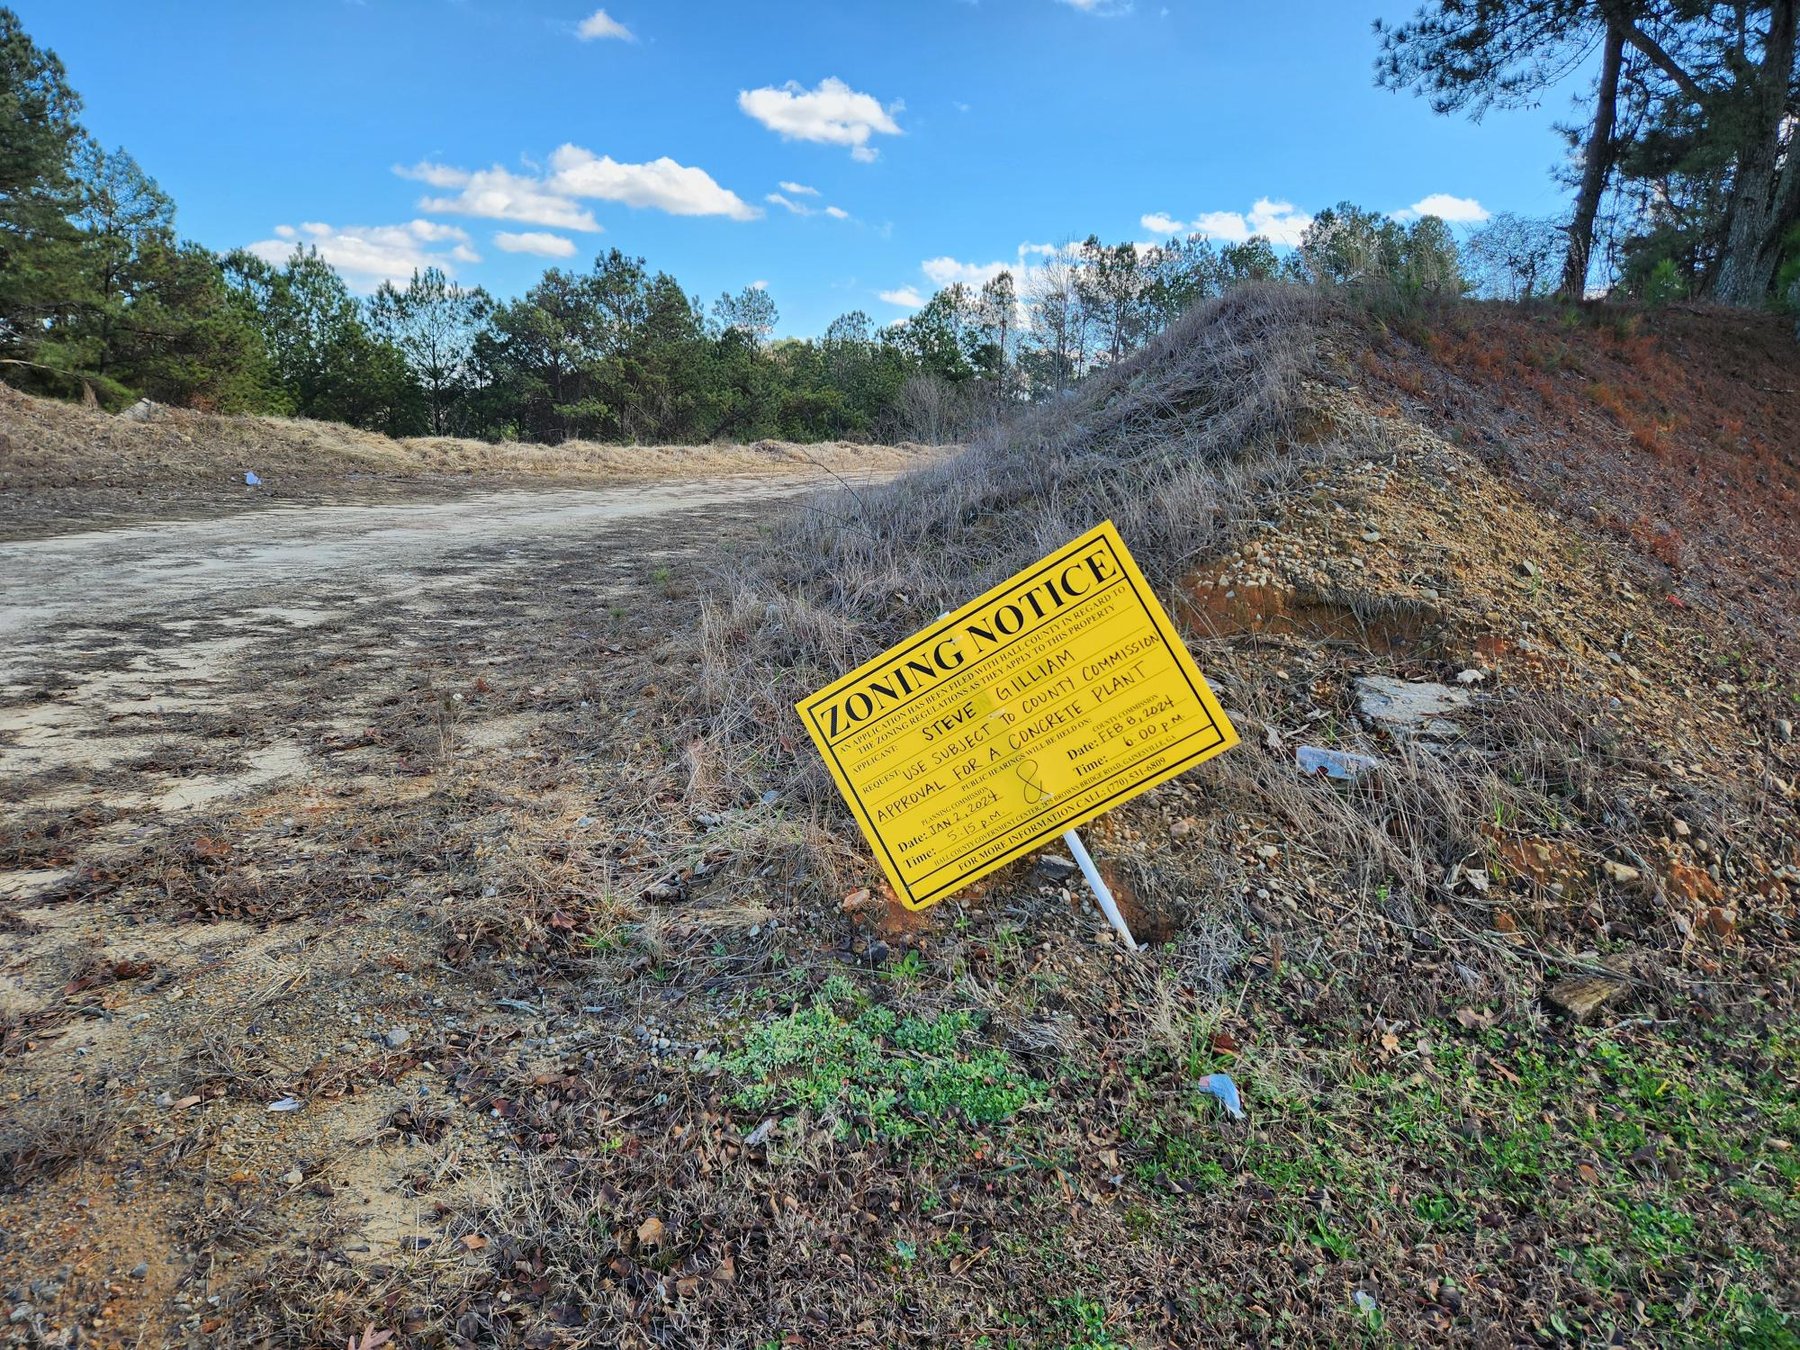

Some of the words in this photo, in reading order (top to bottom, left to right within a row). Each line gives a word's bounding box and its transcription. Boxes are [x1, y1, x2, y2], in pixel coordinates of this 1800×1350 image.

[819, 636, 966, 738] ZONING
[964, 548, 1118, 654] NOTICE
[839, 743, 852, 753] AN
[852, 710, 907, 746] APPLICATION
[907, 701, 925, 715] HAS
[925, 686, 948, 704] BEEN
[948, 672, 974, 691] FILED
[974, 657, 999, 675] WITH
[998, 644, 1024, 662] HALL
[1023, 622, 1061, 648] COUNTY
[1060, 616, 1072, 626] IN
[1072, 593, 1112, 620] REGARD
[1111, 585, 1126, 597] TO
[857, 740, 875, 754] THE
[875, 721, 909, 744] ZONING
[909, 687, 969, 726] REGULATIONS
[969, 680, 980, 691] AS
[979, 666, 1004, 685] THEY
[1005, 650, 1032, 671] APPLY
[1032, 643, 1046, 654] TO
[1046, 631, 1068, 647] THIS
[1067, 603, 1116, 635] PROPERTY
[902, 760, 928, 781] USE
[930, 722, 992, 766] SUBJECT
[998, 710, 1016, 726] TO
[1021, 675, 1076, 715] COUNTY
[1080, 629, 1161, 682] COMMISSION
[921, 701, 978, 742] STEVE
[994, 648, 1075, 702] GILLIAM
[852, 744, 898, 774] APPLICANT:
[862, 768, 902, 794] REQUEST:
[876, 778, 946, 823] APPROVAL
[952, 756, 983, 780] FOR
[987, 746, 1001, 762] A
[1006, 698, 1084, 750] CONCRETE
[1090, 660, 1148, 703] PLANT
[961, 773, 988, 792] PUBLIC
[988, 753, 1026, 777] HEARINGS
[1024, 742, 1046, 756] WILL
[1045, 736, 1056, 746] BE
[1056, 724, 1077, 740] HELD
[1076, 717, 1092, 728] ON:
[1066, 738, 1099, 760] Date:
[1072, 754, 1108, 777] Time:
[897, 831, 928, 853] Date:
[957, 855, 978, 871] FOR
[978, 840, 1008, 859] MORE
[1007, 804, 1075, 844] INFORMATION
[1075, 789, 1106, 808] CALL:
[1105, 776, 1129, 793] (770)
[1128, 756, 1167, 781] 531-6809
[904, 846, 937, 869] Time:
